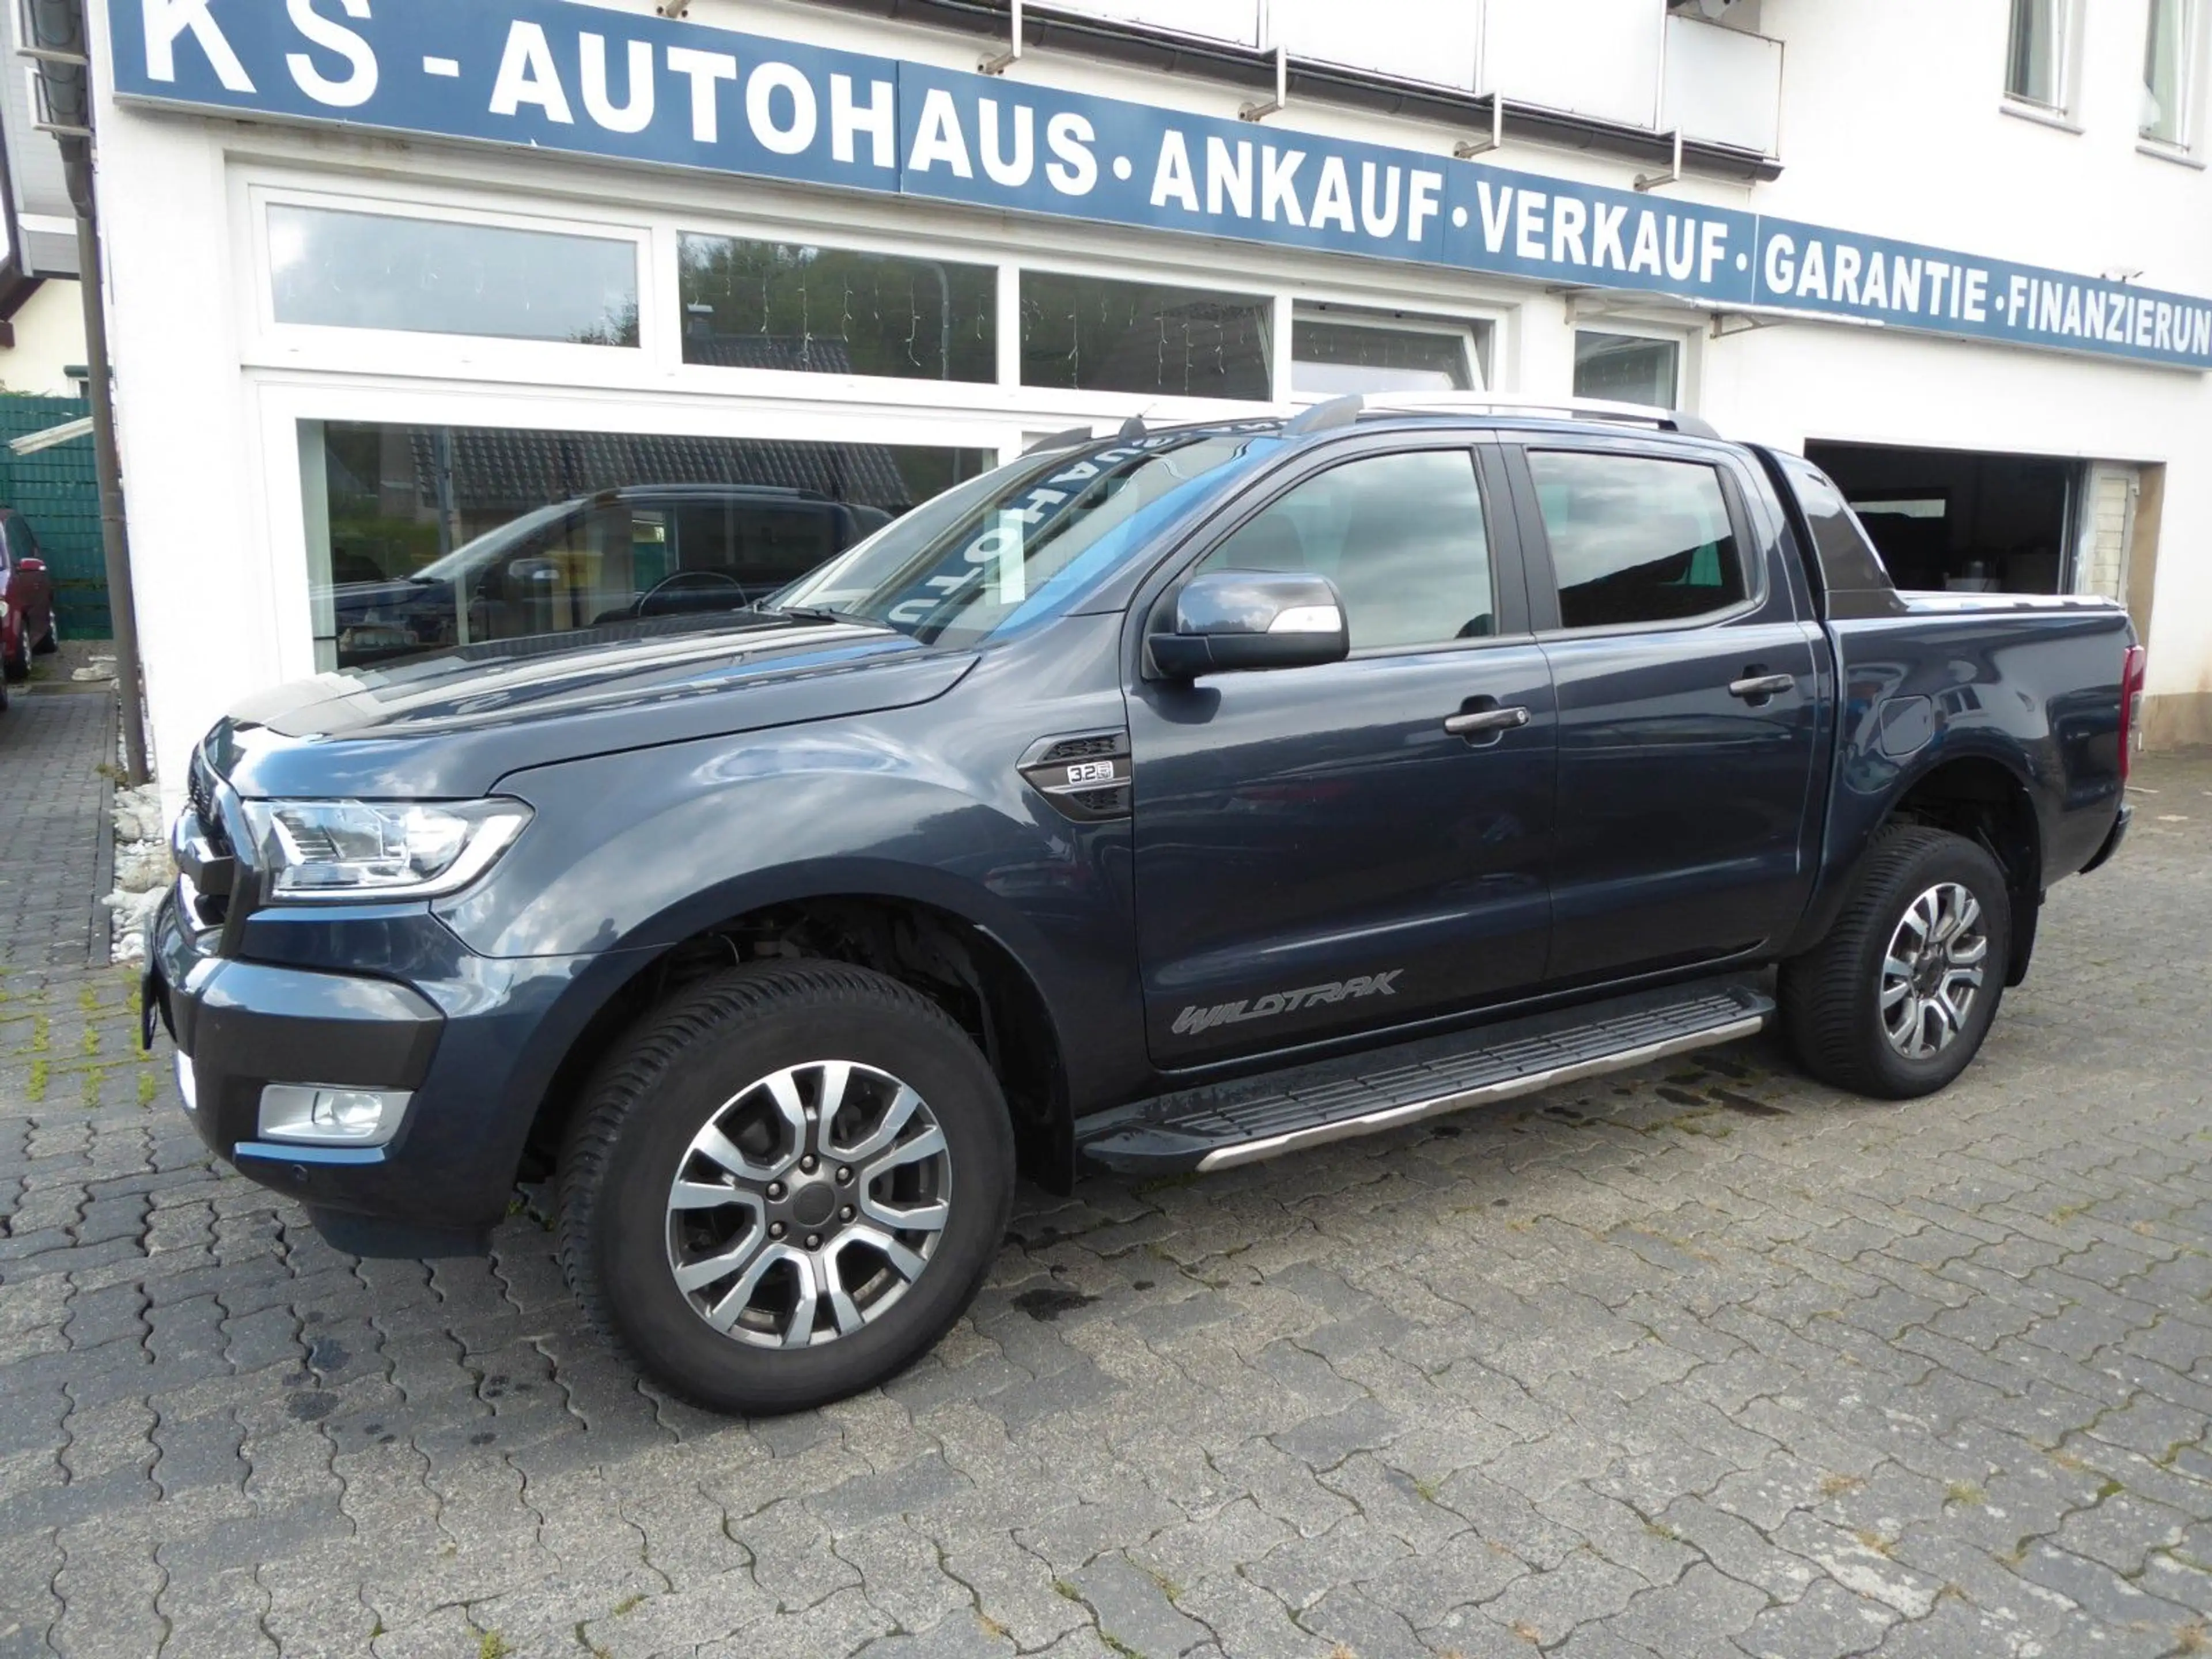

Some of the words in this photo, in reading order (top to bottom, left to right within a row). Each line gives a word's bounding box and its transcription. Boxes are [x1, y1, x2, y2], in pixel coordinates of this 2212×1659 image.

[1150, 129, 1442, 242] ANKAUF
[1476, 180, 1729, 283] VERKAUF
[1764, 233, 1988, 323] GARANTIE
[1171, 968, 1404, 1035] WILDTRAK
